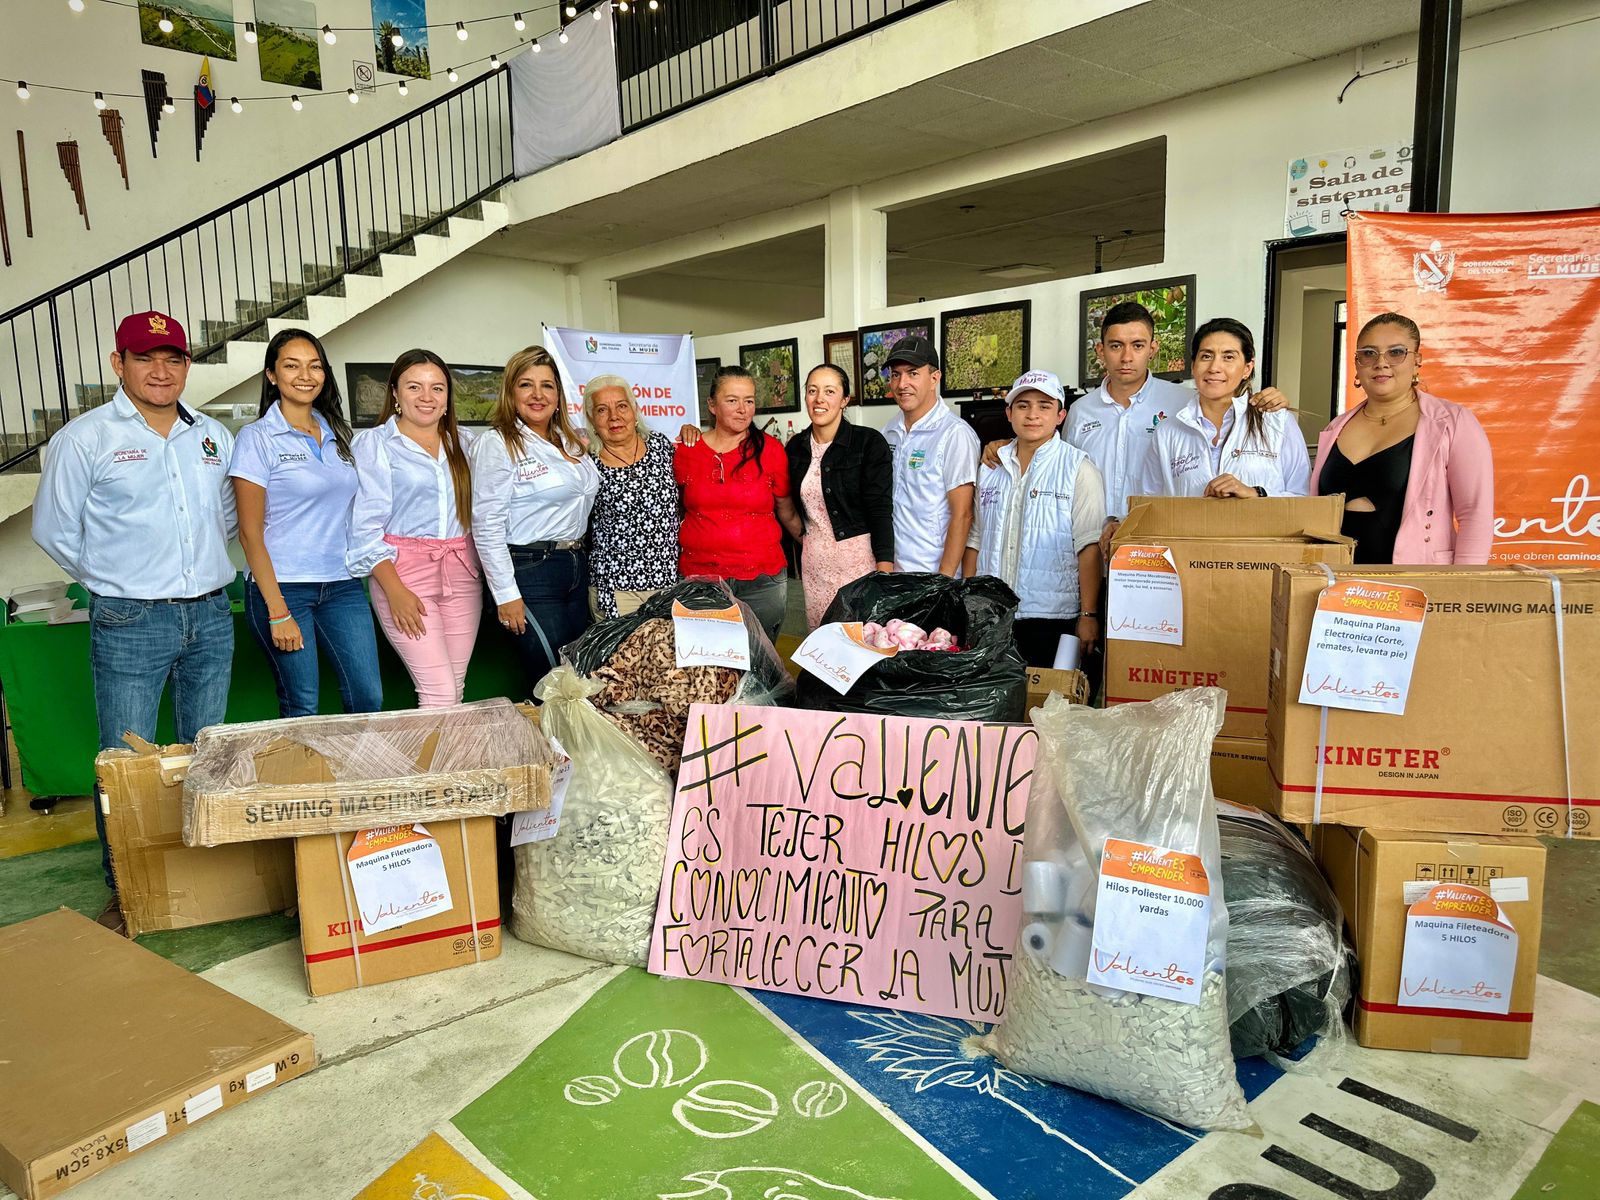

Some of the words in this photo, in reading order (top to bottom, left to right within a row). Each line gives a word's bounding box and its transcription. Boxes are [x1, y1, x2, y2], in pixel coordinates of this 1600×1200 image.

[1309, 172, 1367, 189] Sala
[1372, 166, 1403, 179] de
[1297, 183, 1412, 207] sistemas
[1528, 265, 1547, 275] LA
[1556, 263, 1600, 274] MUJE
[655, 387, 671, 398] DE
[567, 403, 686, 417] EMMIENTO
[1189, 560, 1235, 570] KINGTER
[1500, 553, 1520, 562] que
[1523, 552, 1555, 560] abren
[1557, 552, 1600, 561] caminos
[1345, 586, 1402, 601] #VALIENTES
[1344, 597, 1399, 612] EMPRENDER
[1427, 603, 1461, 613] GTER
[1466, 603, 1522, 614] SEWING
[1110, 616, 1178, 634] Valientes
[1334, 617, 1374, 630] Maquina
[1376, 621, 1401, 632] Plana
[1324, 628, 1373, 642] Electronica
[1375, 634, 1405, 647] (Corte,
[1316, 641, 1354, 653] remates,
[1356, 645, 1388, 657] levanta
[1390, 650, 1408, 660] pie)
[1306, 673, 1400, 699] Valientes
[1241, 754, 1266, 762] SEWING
[1378, 771, 1406, 779] DESIGN
[1415, 772, 1439, 780] JAPAN
[245, 799, 333, 825] SEWING
[340, 789, 436, 817] MACHINE
[443, 782, 509, 807] STAND
[1538, 812, 1554, 823] CE
[1571, 812, 1586, 820] SO
[682, 806, 722, 863] ES
[747, 804, 844, 864] TEJER
[880, 817, 987, 887] HILOS
[356, 854, 390, 869] Maquina
[391, 843, 433, 859] Fileteadora
[389, 858, 411, 870] HILOS
[1131, 851, 1186, 872] #VALIENTES
[1131, 863, 1186, 882] EMPRENDER
[1490, 869, 1496, 877] 8
[1106, 881, 1130, 894] Hilos
[1131, 884, 1171, 902] Poliester
[1173, 895, 1204, 909] 10.000
[1435, 889, 1493, 908] #VALIENTES
[363, 891, 446, 925] Valientes
[670, 861, 887, 939] CONOCIMIENTO
[909, 888, 1004, 951] PARA
[1139, 903, 1169, 917] yardas
[1435, 900, 1492, 915] EMPRENDER
[1414, 920, 1454, 930] Maquina
[1456, 922, 1510, 940] Fileteadora
[1441, 933, 1447, 941] 5
[1449, 935, 1477, 944] HILOS
[663, 924, 864, 996] FORTALECER
[879, 948, 926, 1001] LA
[949, 952, 1013, 1017] MUJ
[1094, 948, 1195, 986] Valientes
[1404, 977, 1502, 999] Valientes
[229, 1079, 245, 1093] kg
[71, 1134, 107, 1158] Plana
